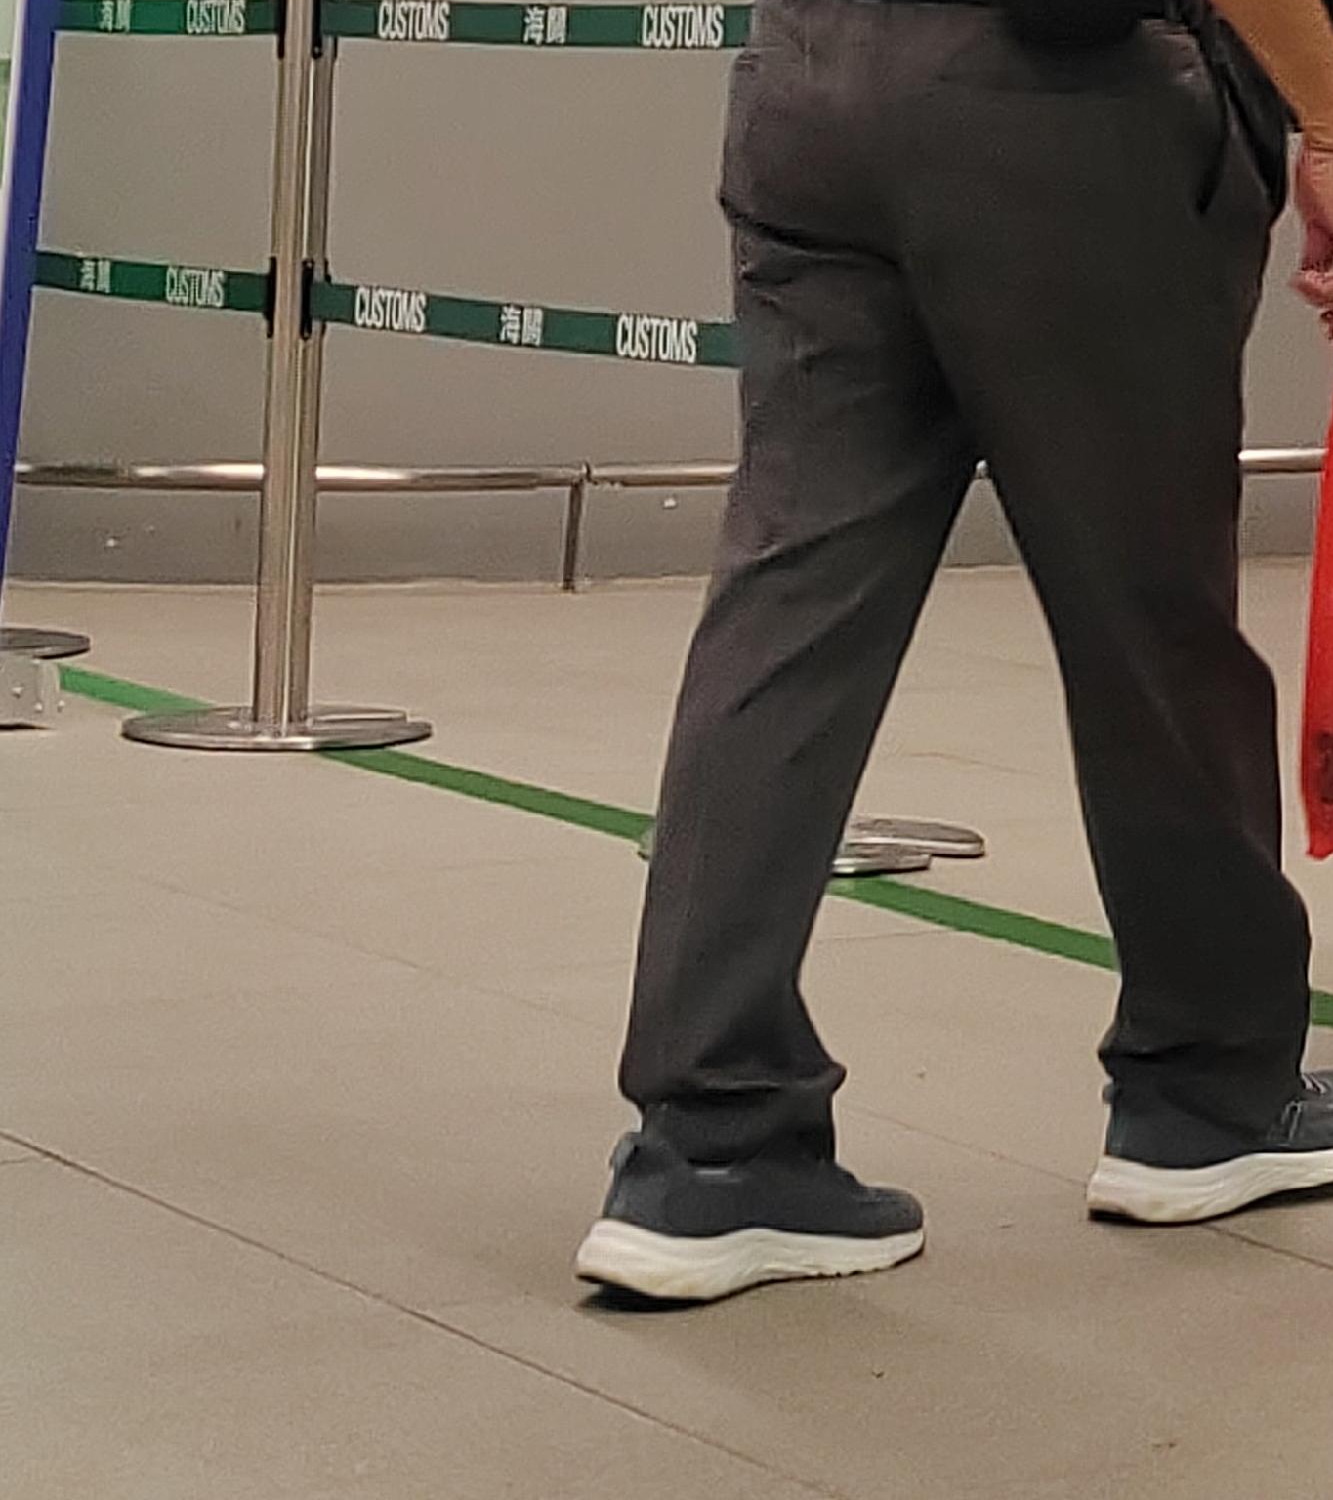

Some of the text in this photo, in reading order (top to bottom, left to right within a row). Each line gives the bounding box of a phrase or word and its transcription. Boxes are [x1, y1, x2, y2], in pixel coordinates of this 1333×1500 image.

[377, 0, 450, 41] CUSTOMS
[641, 4, 725, 50] CUSTOMS
[165, 266, 226, 308] CUSTOMS
[353, 285, 427, 334] CUSTOMS
[615, 313, 698, 365] CUSTOMS
